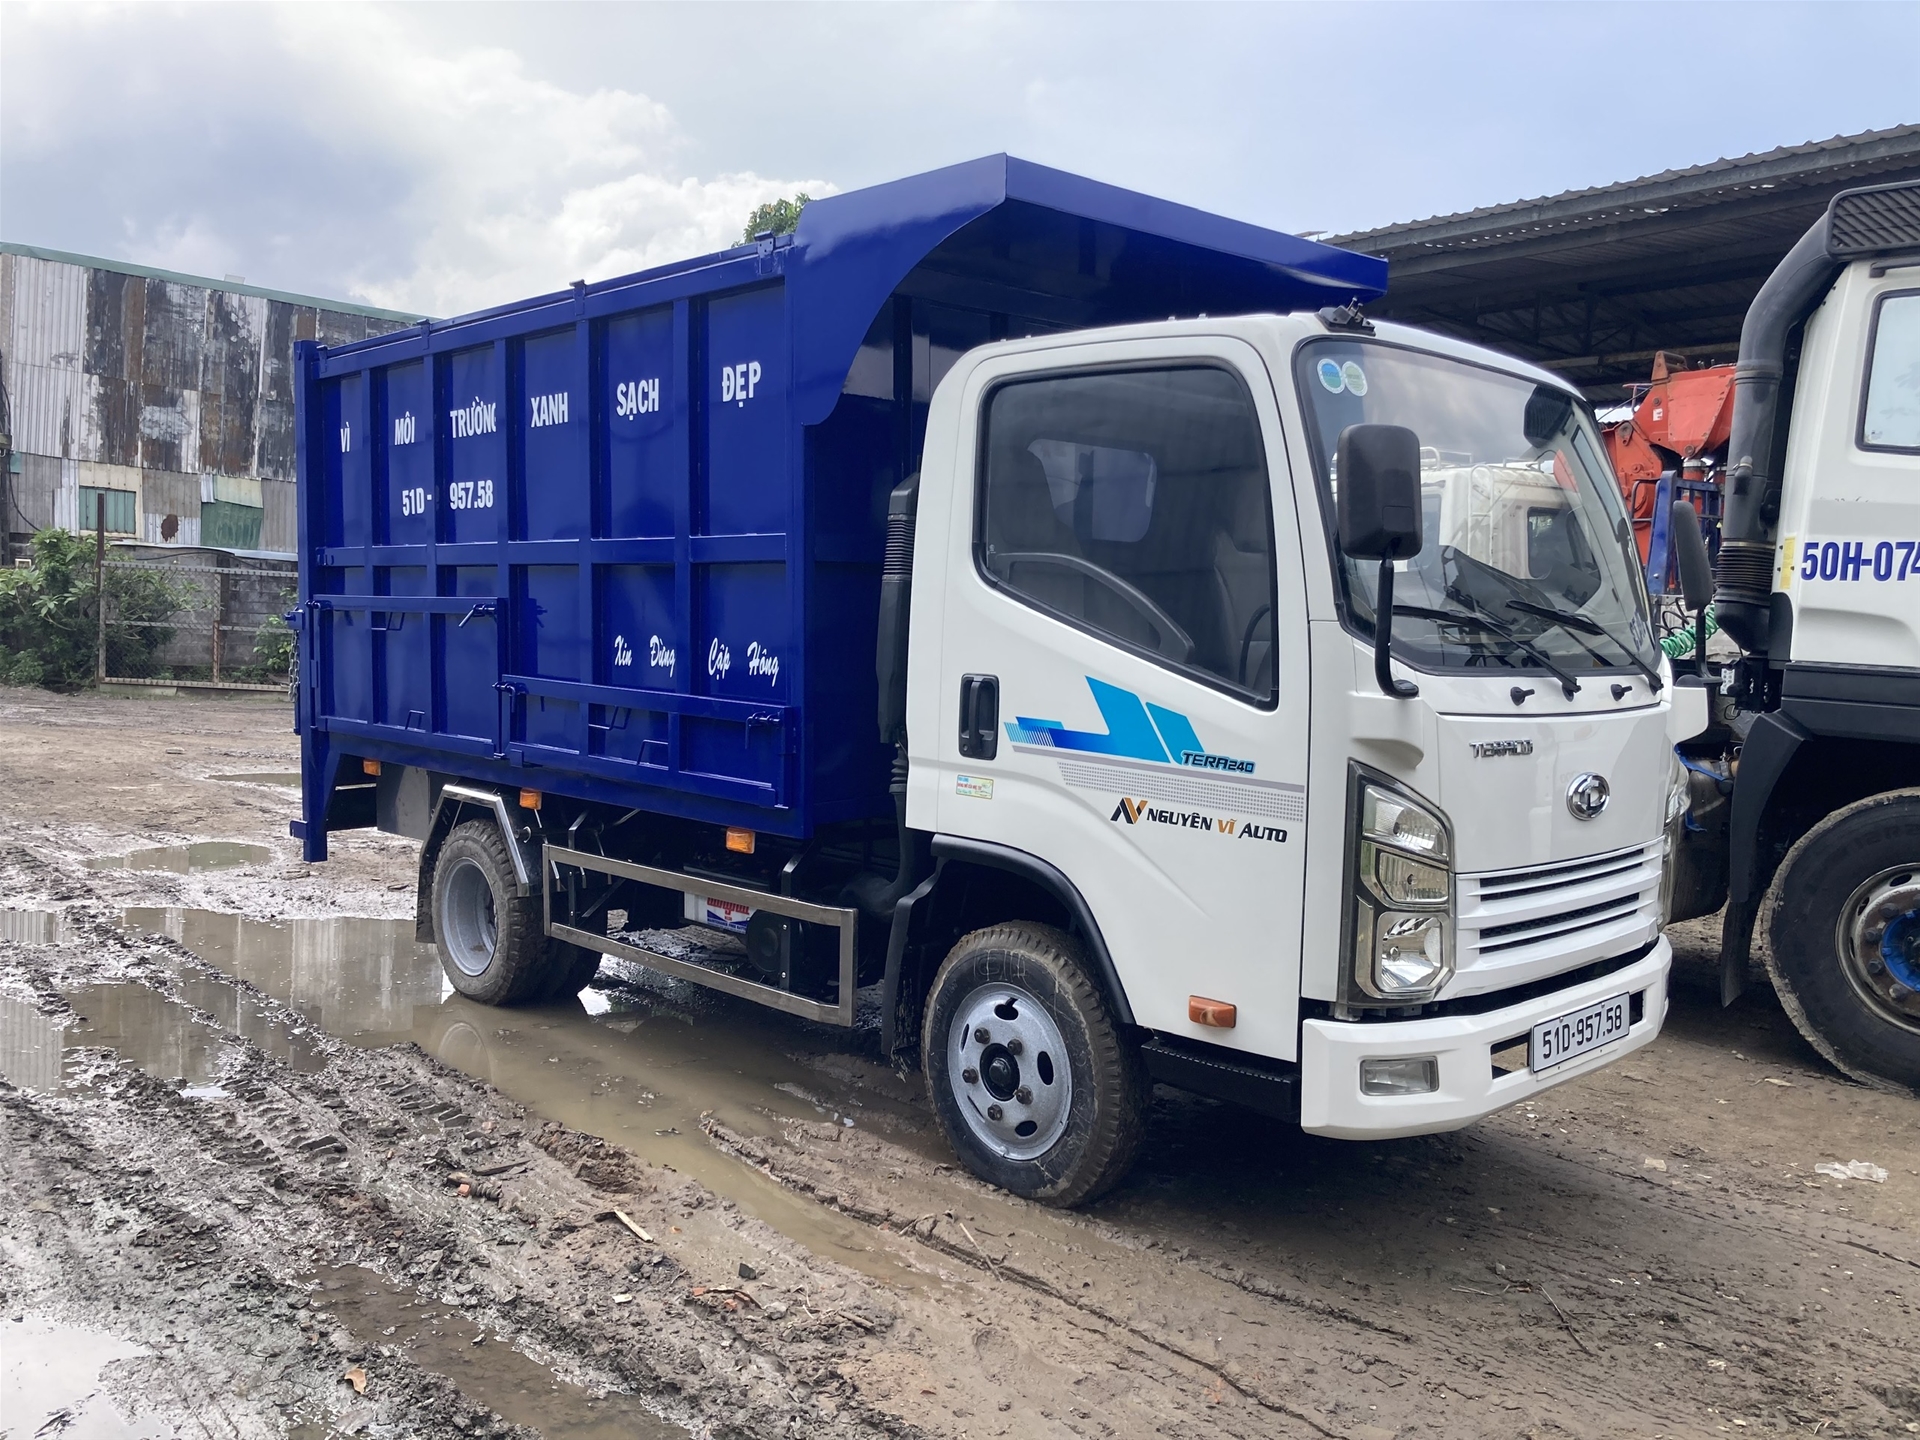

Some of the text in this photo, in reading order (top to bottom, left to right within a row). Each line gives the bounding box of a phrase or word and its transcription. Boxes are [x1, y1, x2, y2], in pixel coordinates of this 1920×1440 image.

[340, 421, 351, 453] VÌ
[394, 410, 416, 446] MÔI
[530, 391, 569, 428] XANH
[616, 378, 660, 421] SẠCH
[721, 361, 762, 408] ĐẸP
[449, 479, 494, 510] 957.58
[614, 634, 633, 667] Xin
[708, 637, 731, 680] Cập
[747, 640, 780, 687] Hông
[1182, 752, 1255, 773] TERA240
[1146, 807, 1213, 831] NGUYÊN
[1238, 822, 1288, 843] AUTO
[1542, 1004, 1622, 1060] 51D-957.58
